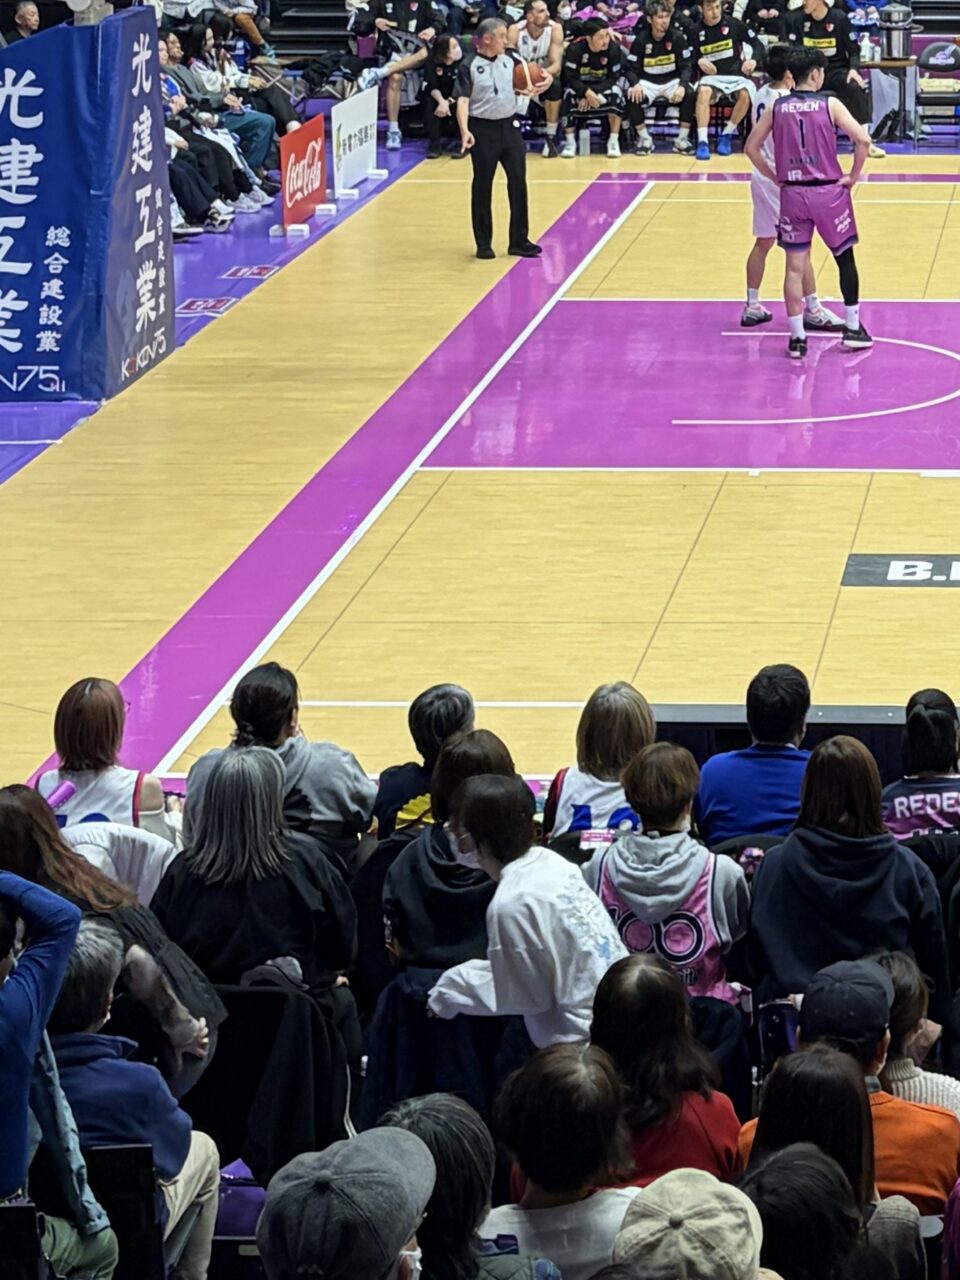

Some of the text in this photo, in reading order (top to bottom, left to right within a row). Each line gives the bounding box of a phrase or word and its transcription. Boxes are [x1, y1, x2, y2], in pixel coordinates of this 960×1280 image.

[781, 101, 820, 113] REDEN
[799, 119, 806, 149] 1
[131, 32, 156, 333] 光建工業
[35, 226, 71, 352] 総合建設業
